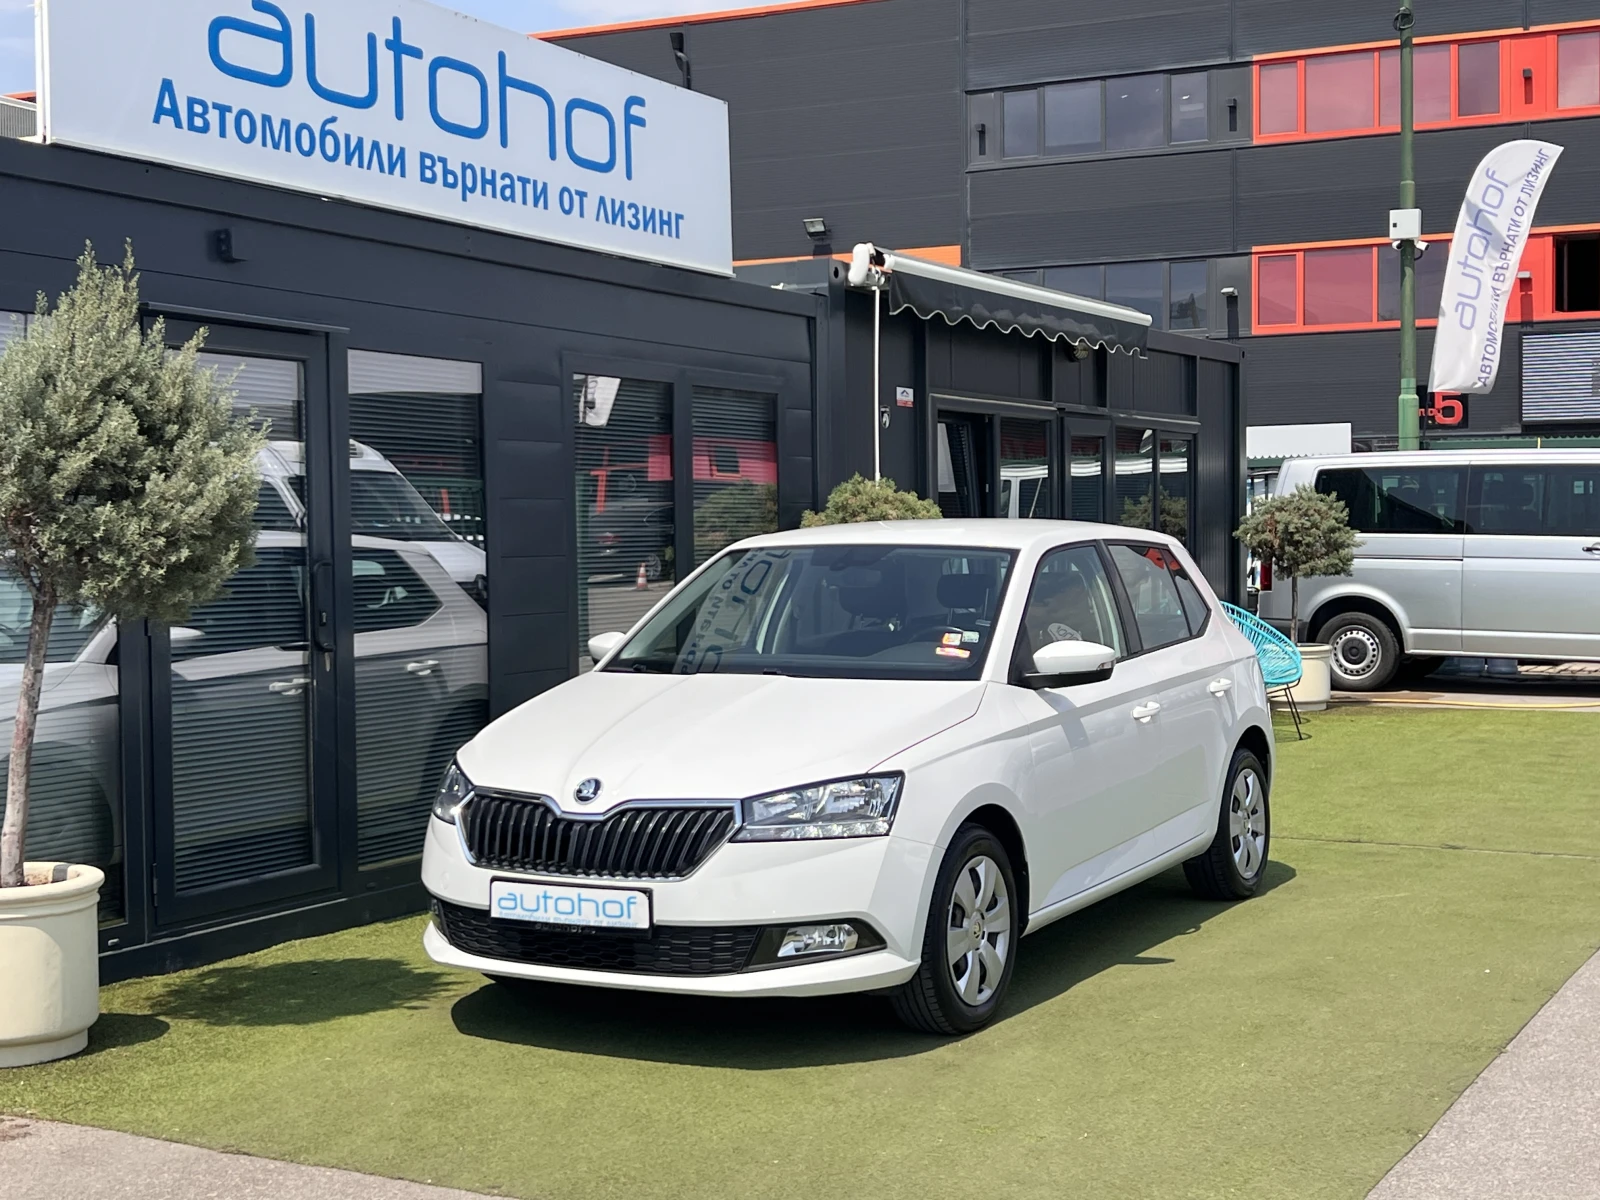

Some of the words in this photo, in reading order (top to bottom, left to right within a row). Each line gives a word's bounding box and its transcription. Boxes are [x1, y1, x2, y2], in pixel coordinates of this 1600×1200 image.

[207, 0, 646, 181] autohof
[152, 77, 408, 179] Автомобили
[418, 150, 549, 211] върнати
[558, 185, 588, 219] от
[595, 195, 685, 240] лизинг
[1521, 148, 1551, 198] ЛИЗИНГ
[1514, 202, 1530, 217] ОТ
[1455, 167, 1509, 330] autohof
[1492, 219, 1518, 284] ВЪРНАТИ
[497, 890, 638, 919] autohof
